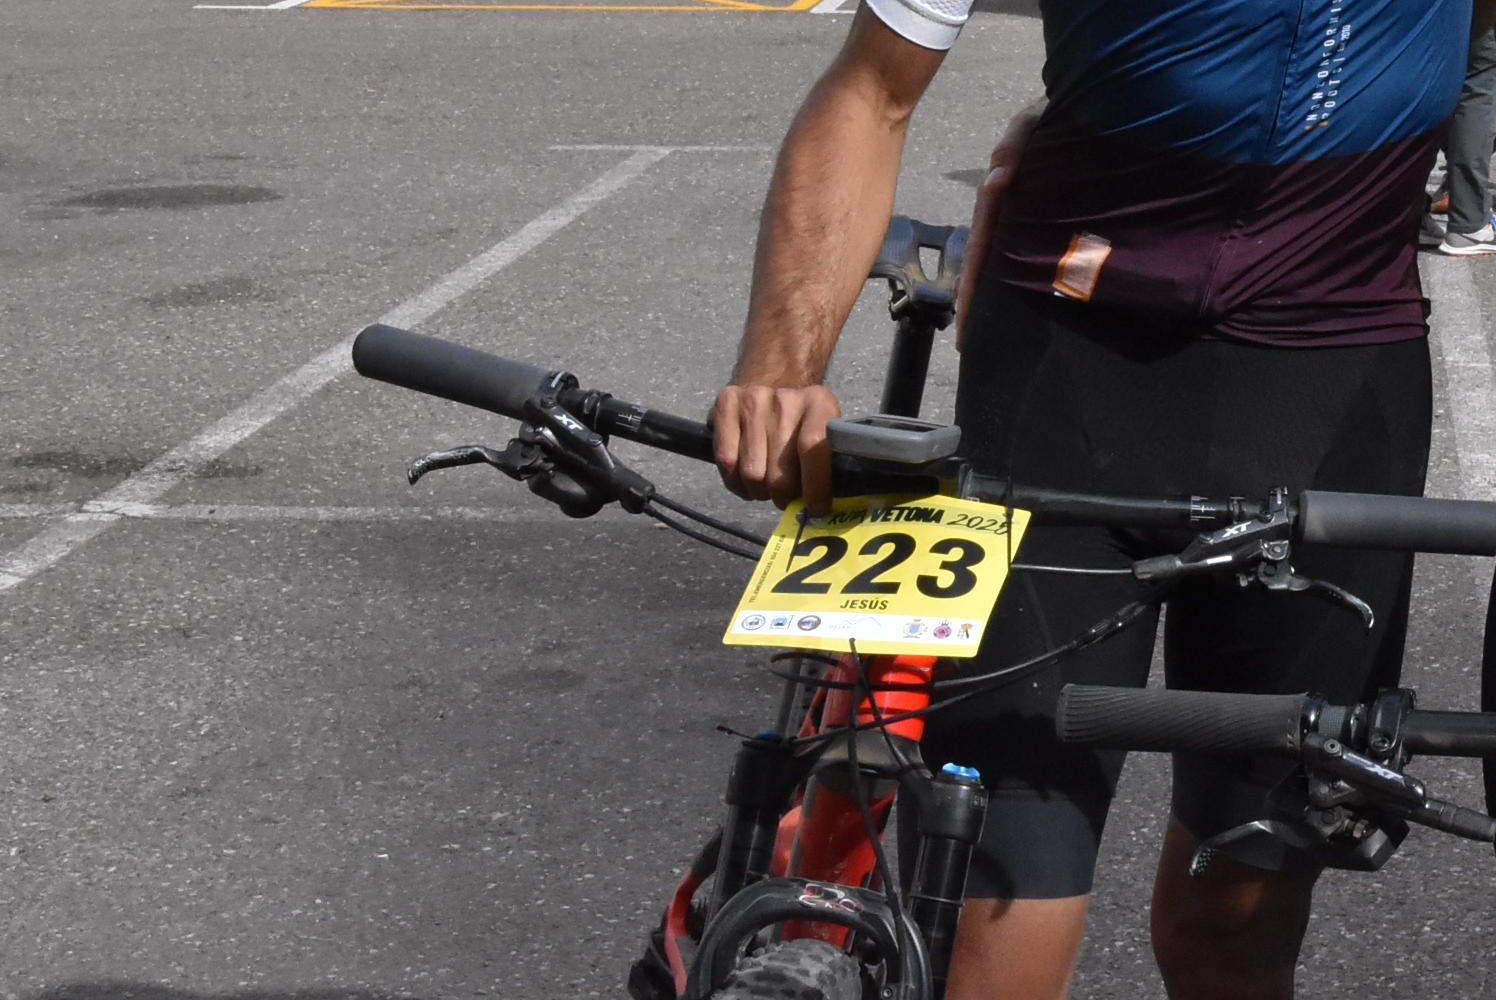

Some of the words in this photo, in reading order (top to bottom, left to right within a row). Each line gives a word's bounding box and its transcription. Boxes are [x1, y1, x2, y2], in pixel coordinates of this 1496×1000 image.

[553, 414, 584, 430] XT
[870, 505, 946, 524] VETONA
[1222, 521, 1252, 538] XT
[770, 532, 986, 599] 223
